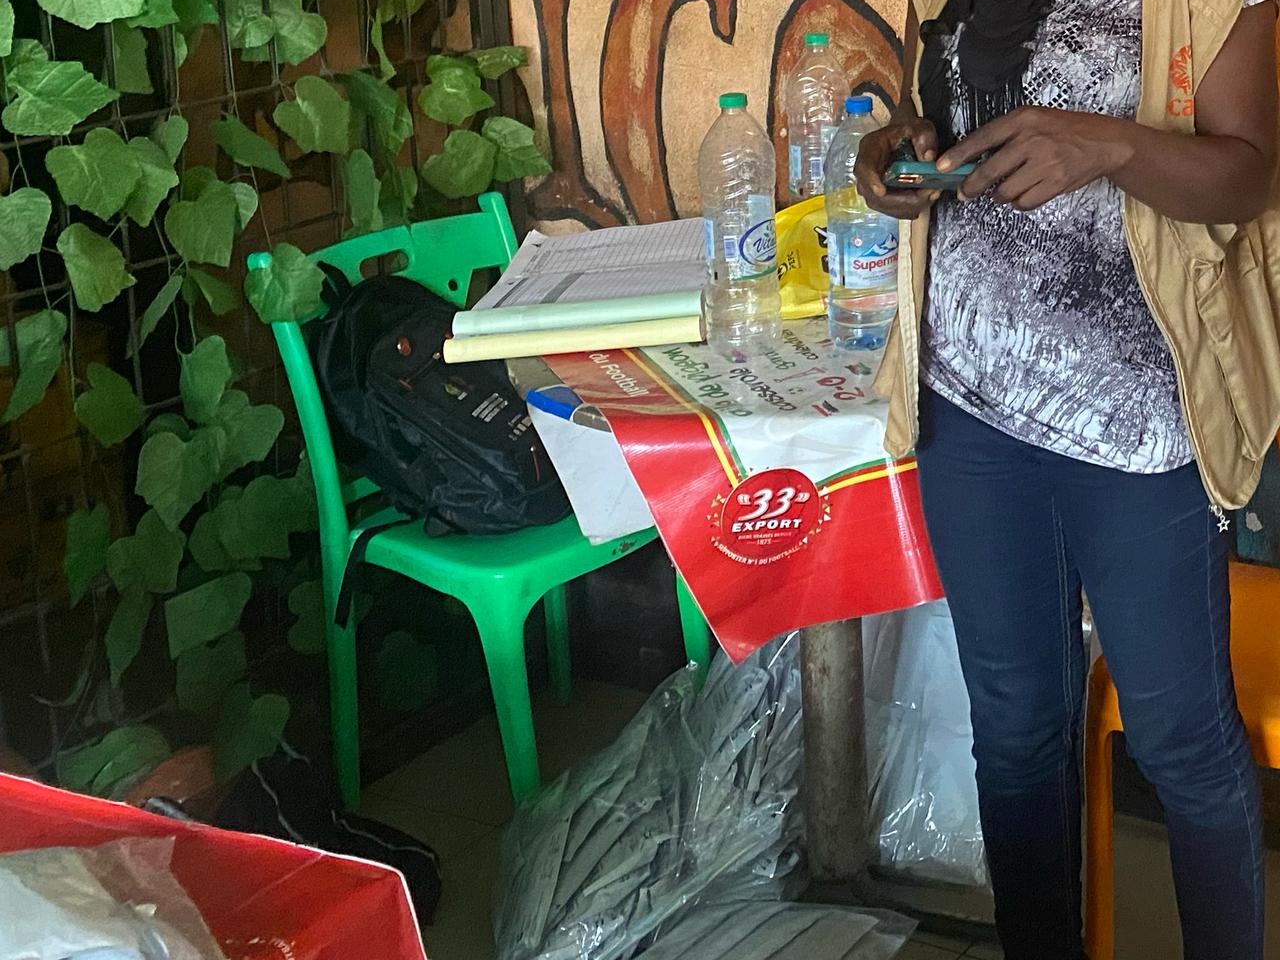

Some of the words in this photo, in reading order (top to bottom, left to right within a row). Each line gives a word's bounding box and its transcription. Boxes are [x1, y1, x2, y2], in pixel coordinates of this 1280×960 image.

[600, 363, 650, 398] Football
[730, 367, 797, 412] casserole
[731, 518, 803, 533] EXPORT
